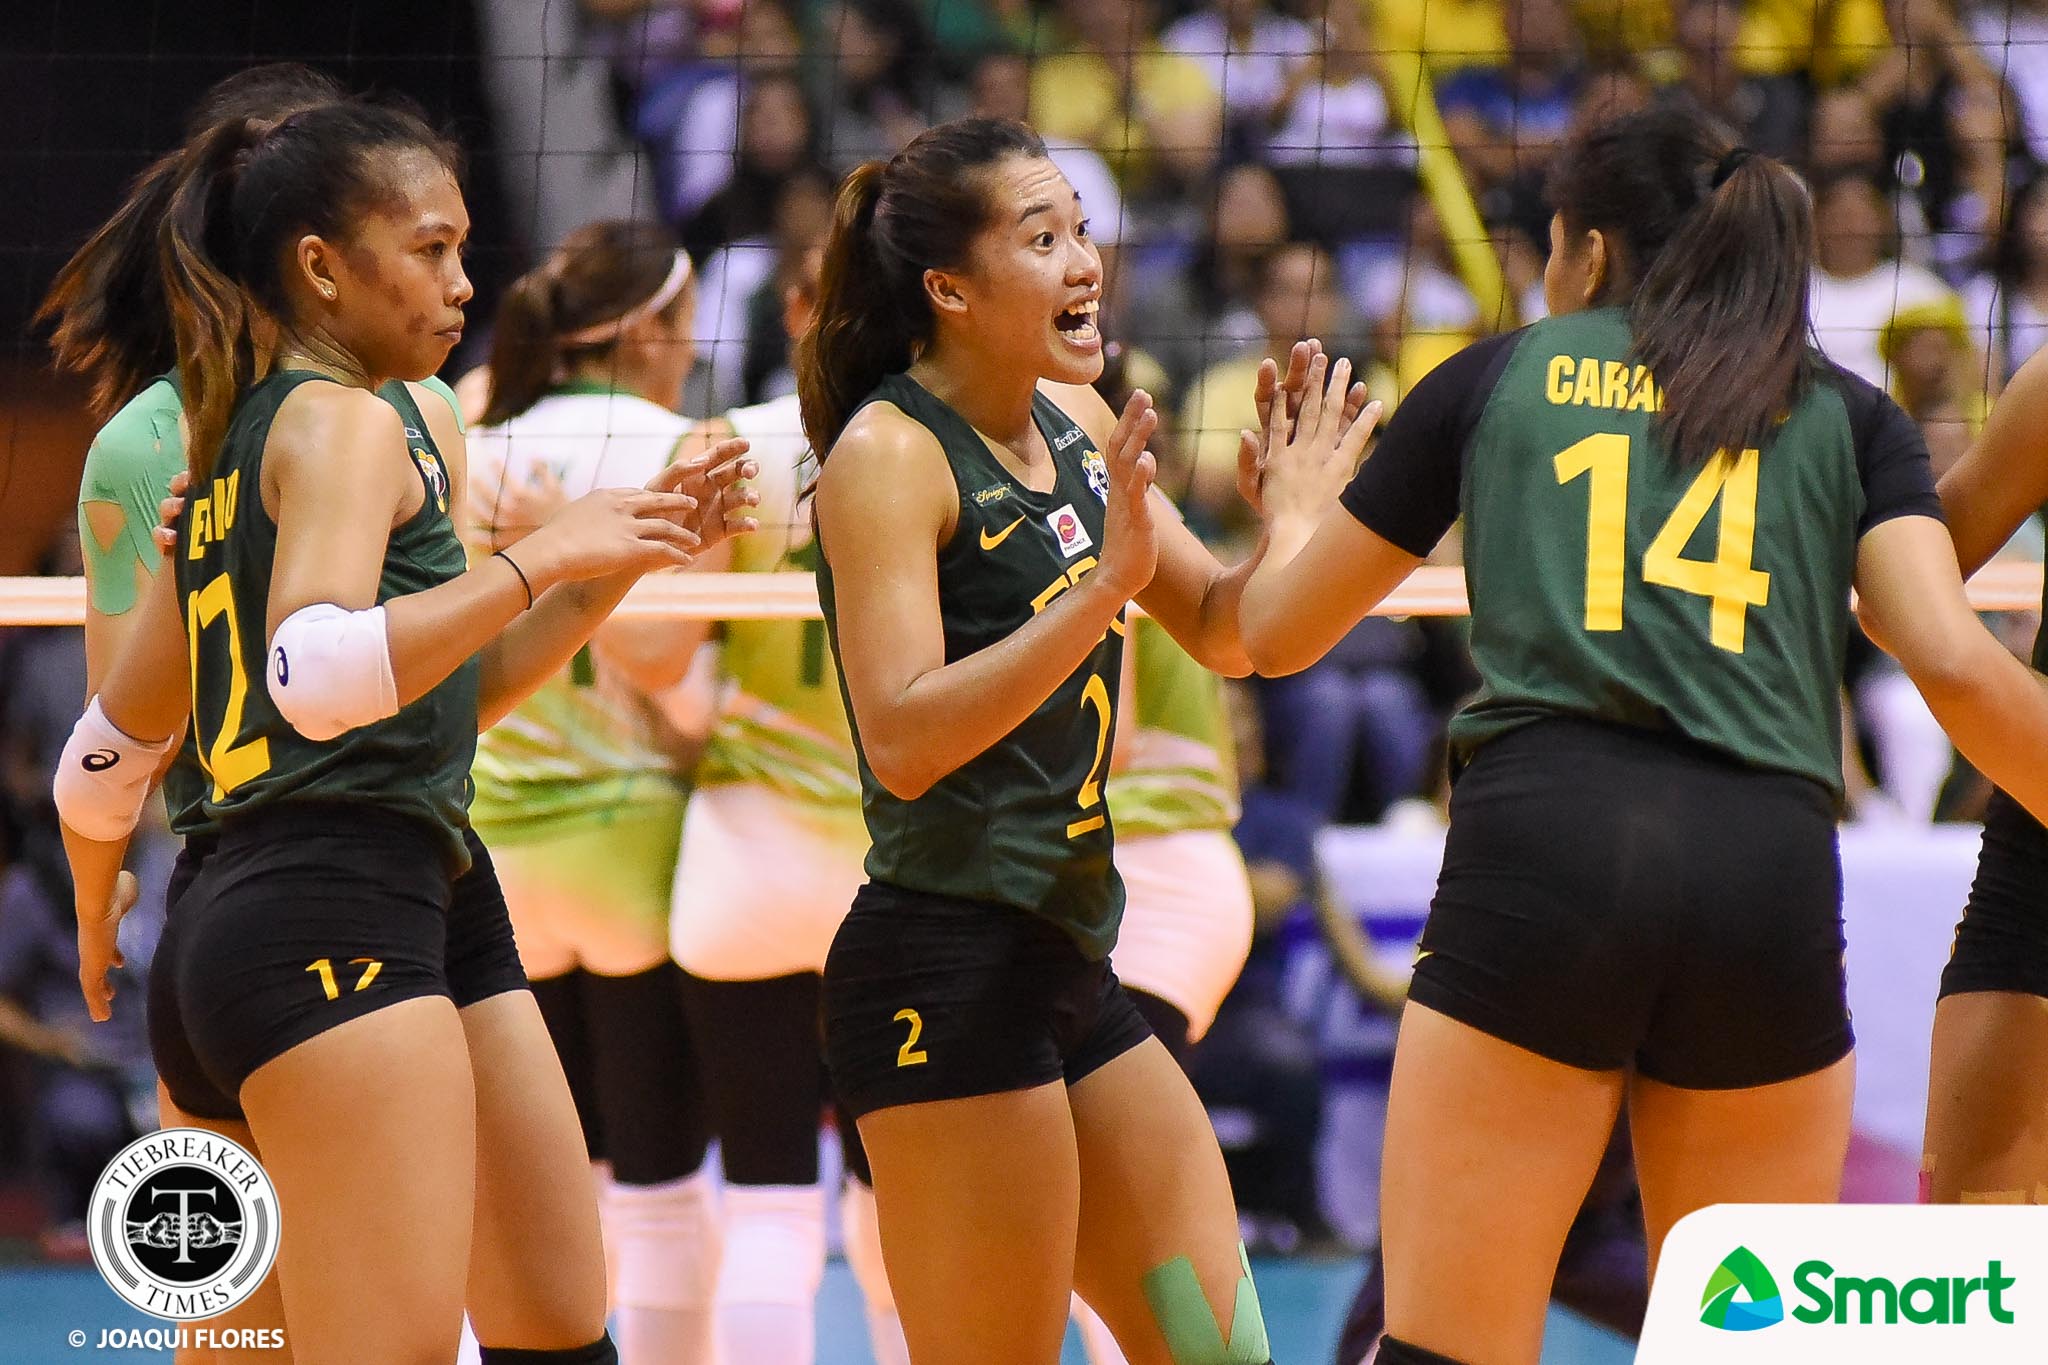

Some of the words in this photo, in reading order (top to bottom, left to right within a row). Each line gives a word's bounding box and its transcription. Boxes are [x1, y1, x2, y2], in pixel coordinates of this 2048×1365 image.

[1545, 354, 1667, 413] CARA
[1553, 432, 1771, 655] 14
[188, 571, 271, 804] 12
[1077, 673, 1111, 810] 2
[893, 1008, 928, 1068] 2
